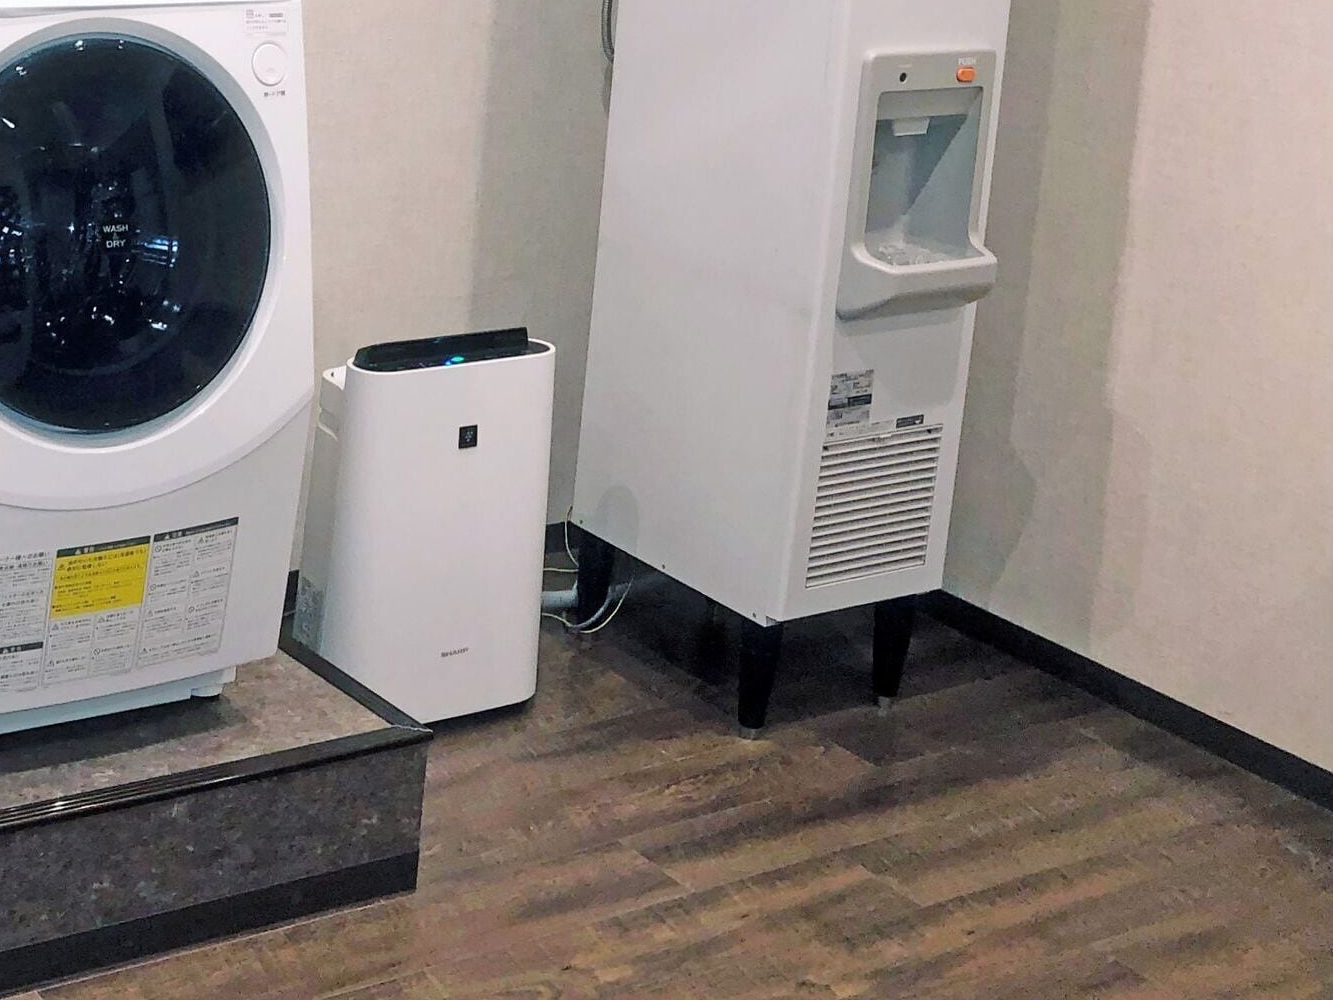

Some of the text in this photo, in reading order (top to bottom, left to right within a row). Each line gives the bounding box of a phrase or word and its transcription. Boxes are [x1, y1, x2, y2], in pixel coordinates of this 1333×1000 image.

[102, 224, 129, 233] WASH
[106, 239, 126, 248] DRY
[441, 647, 469, 657] SHARP
